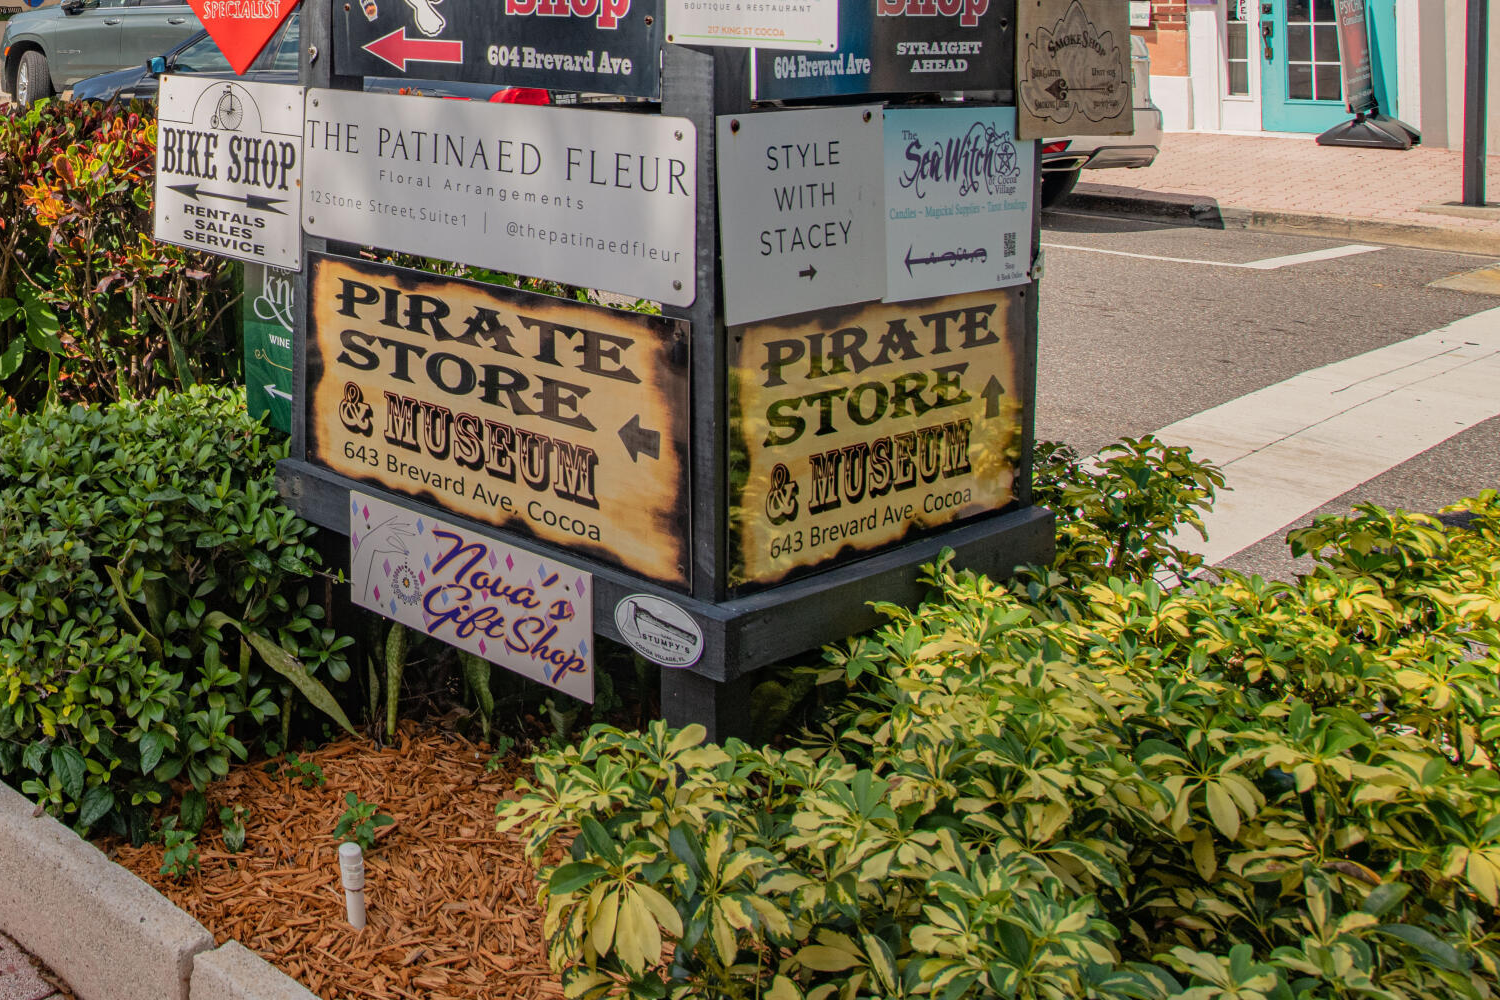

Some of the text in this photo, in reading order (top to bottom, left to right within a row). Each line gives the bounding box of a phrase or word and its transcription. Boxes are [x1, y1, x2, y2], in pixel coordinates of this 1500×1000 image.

[203, 0, 281, 20] SPECIALIST
[684, 2, 812, 13] BOUTIQUE & RESTAURANT
[708, 26, 785, 37] 217 KING ST COCOA
[487, 45, 632, 75] 604 Brevard Ave
[896, 41, 982, 55] STRAIGHT
[774, 53, 871, 79] 604 Brevard Ave
[910, 59, 968, 72] AHEAD
[902, 130, 918, 140] The
[162, 127, 295, 191] BIKE SHOP
[307, 119, 690, 197] THE PATINAED FLEUR
[767, 141, 840, 171] STYLE
[379, 169, 586, 211] Floral Arrangements
[995, 184, 1016, 195] Village
[997, 175, 1017, 184] Cocoa
[324, 192, 363, 210] Stone
[774, 182, 835, 212] WITH
[183, 204, 265, 229] RENTALS
[194, 218, 253, 240] SALES
[889, 208, 916, 220] Candles
[183, 230, 265, 256] SERVICE
[506, 221, 682, 265] @thepatinaedfleur
[760, 220, 851, 256] STACEY
[269, 334, 290, 349] WINE
[337, 277, 642, 384] PIRATE
[761, 304, 1000, 388] PIRATE
[337, 329, 597, 433] STORE
[763, 362, 972, 448] STORE
[339, 381, 599, 508] & MUSEUM
[766, 418, 972, 526] & MUSEUM
[344, 441, 600, 542] 643 Brevard Ave, Cocoa
[770, 488, 972, 559] 643 Brevard Ave, Cocoa
[431, 528, 574, 621] Nova's
[422, 583, 586, 685] Gift Shop
[635, 641, 653, 655] COCOA
[642, 633, 690, 654] STUMPY'S
